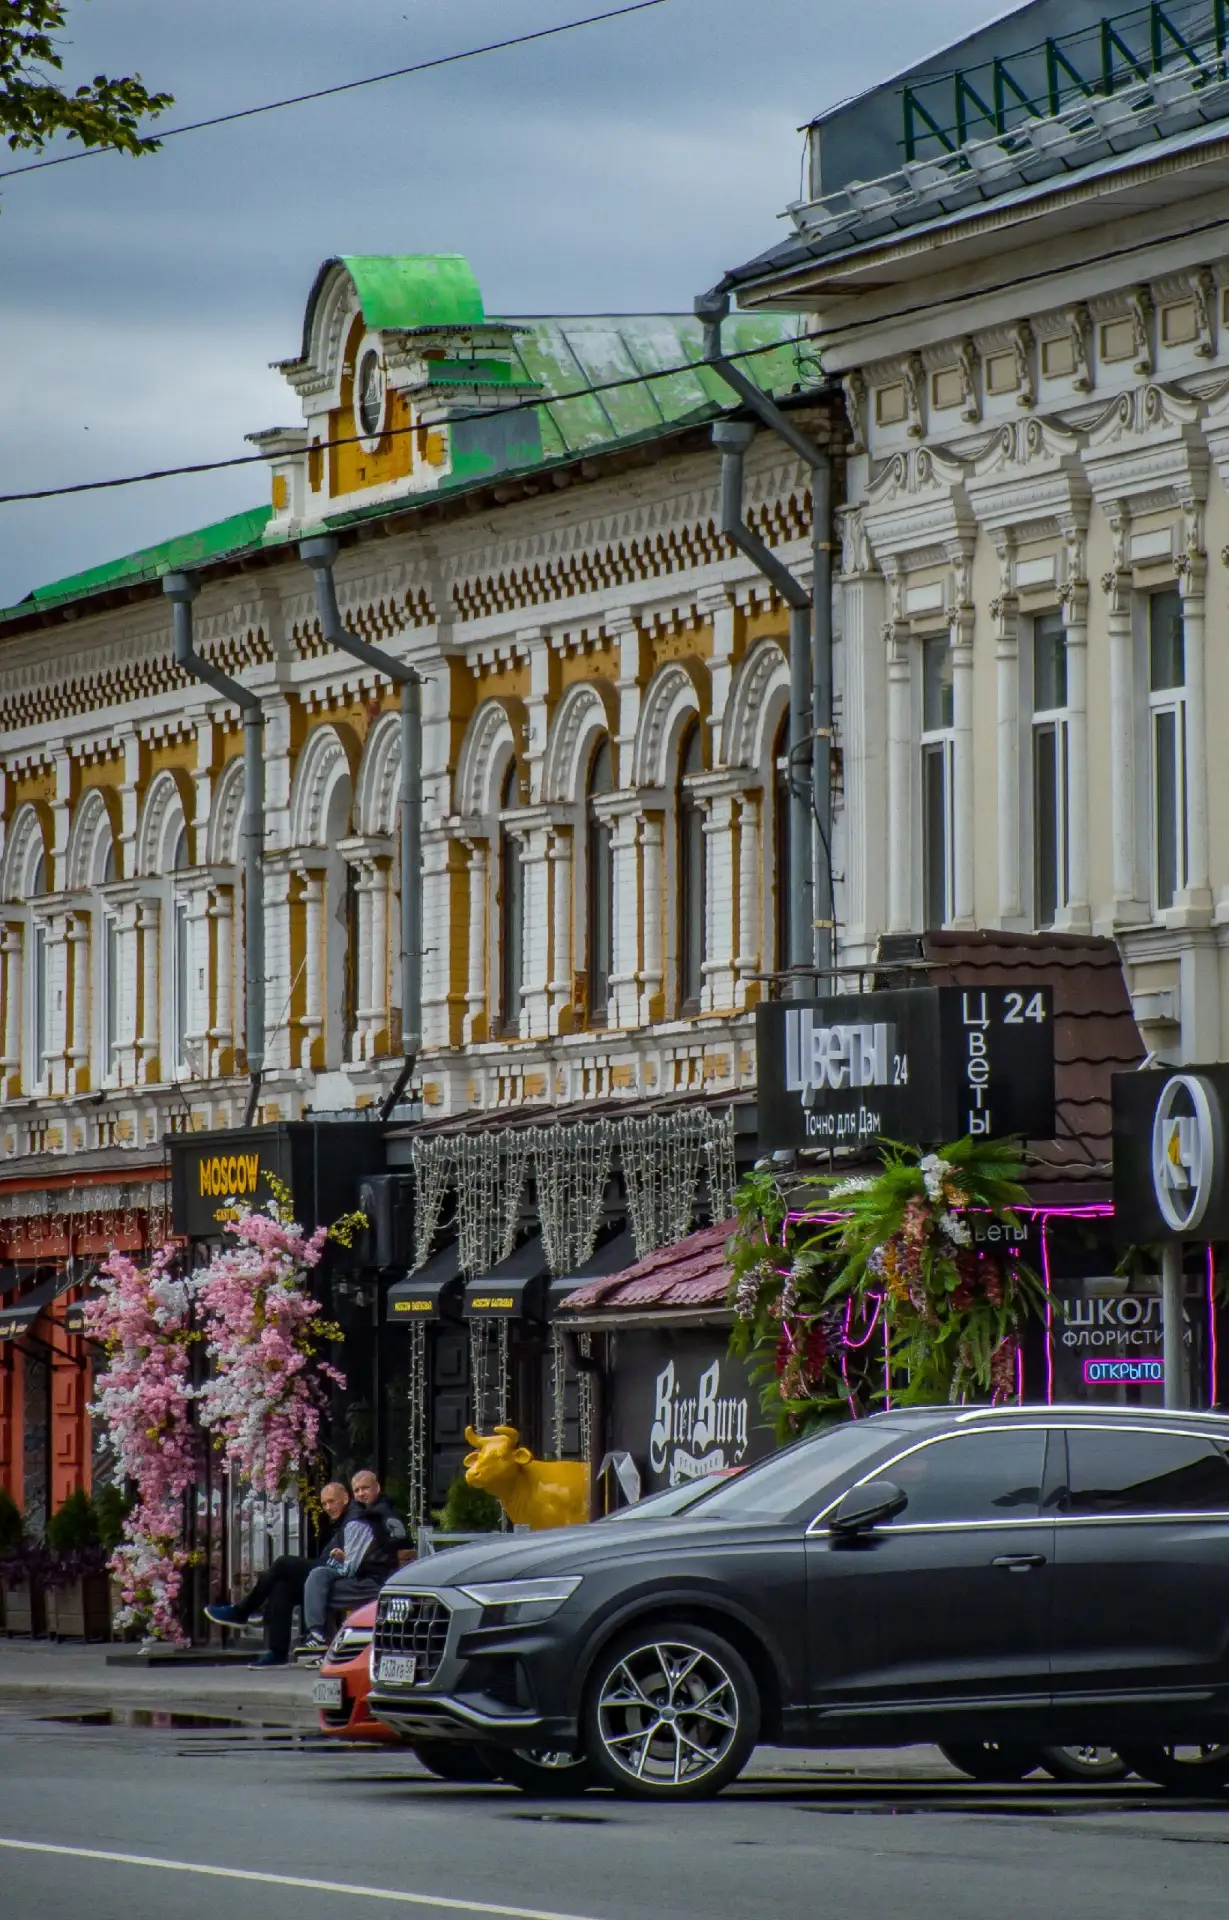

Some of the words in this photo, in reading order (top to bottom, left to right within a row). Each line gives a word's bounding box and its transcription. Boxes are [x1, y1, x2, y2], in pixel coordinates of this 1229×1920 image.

[1003, 992, 1046, 1023] 24
[785, 1008, 895, 1106] Цветы
[893, 1053, 908, 1085] 24
[962, 992, 990, 1134] Цветы
[803, 1109, 835, 1136] Точно
[836, 1112, 856, 1139] для
[858, 1105, 881, 1139] Дам
[200, 1153, 259, 1197] MOSCOW
[1062, 1329, 1193, 1347] ФЛОРИСТИИ
[1089, 1363, 1162, 1380] ОТКРЫТО
